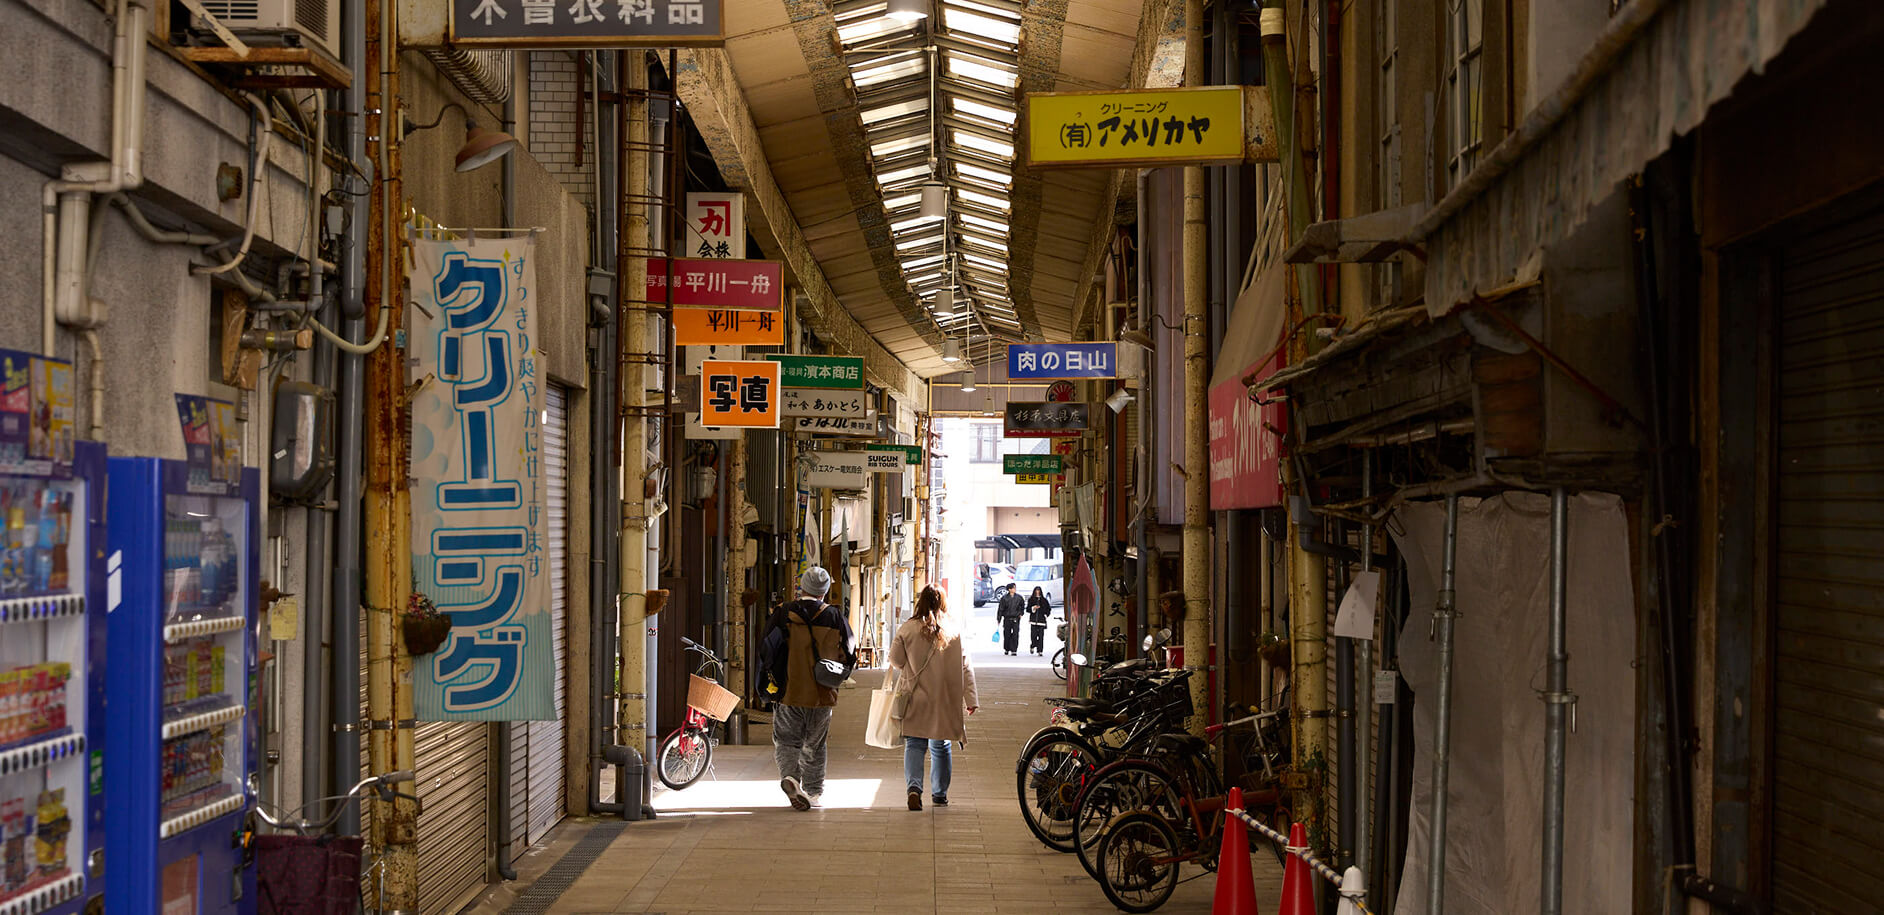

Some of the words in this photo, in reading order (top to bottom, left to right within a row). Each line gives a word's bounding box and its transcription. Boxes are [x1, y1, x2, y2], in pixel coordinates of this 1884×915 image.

[1100, 101, 1168, 115] クリーニング
[685, 272, 770, 294] 平川一舟
[706, 310, 776, 332] 平川一舟
[1017, 350, 1107, 372] 肉の日山
[708, 375, 770, 413] 写真
[511, 256, 543, 577] すっきり爽やかに仕上げます
[813, 398, 860, 413] あかとら
[850, 421, 873, 431] 美容室
[1007, 459, 1059, 469] ほった洋品店
[433, 251, 528, 713] クリーニング
